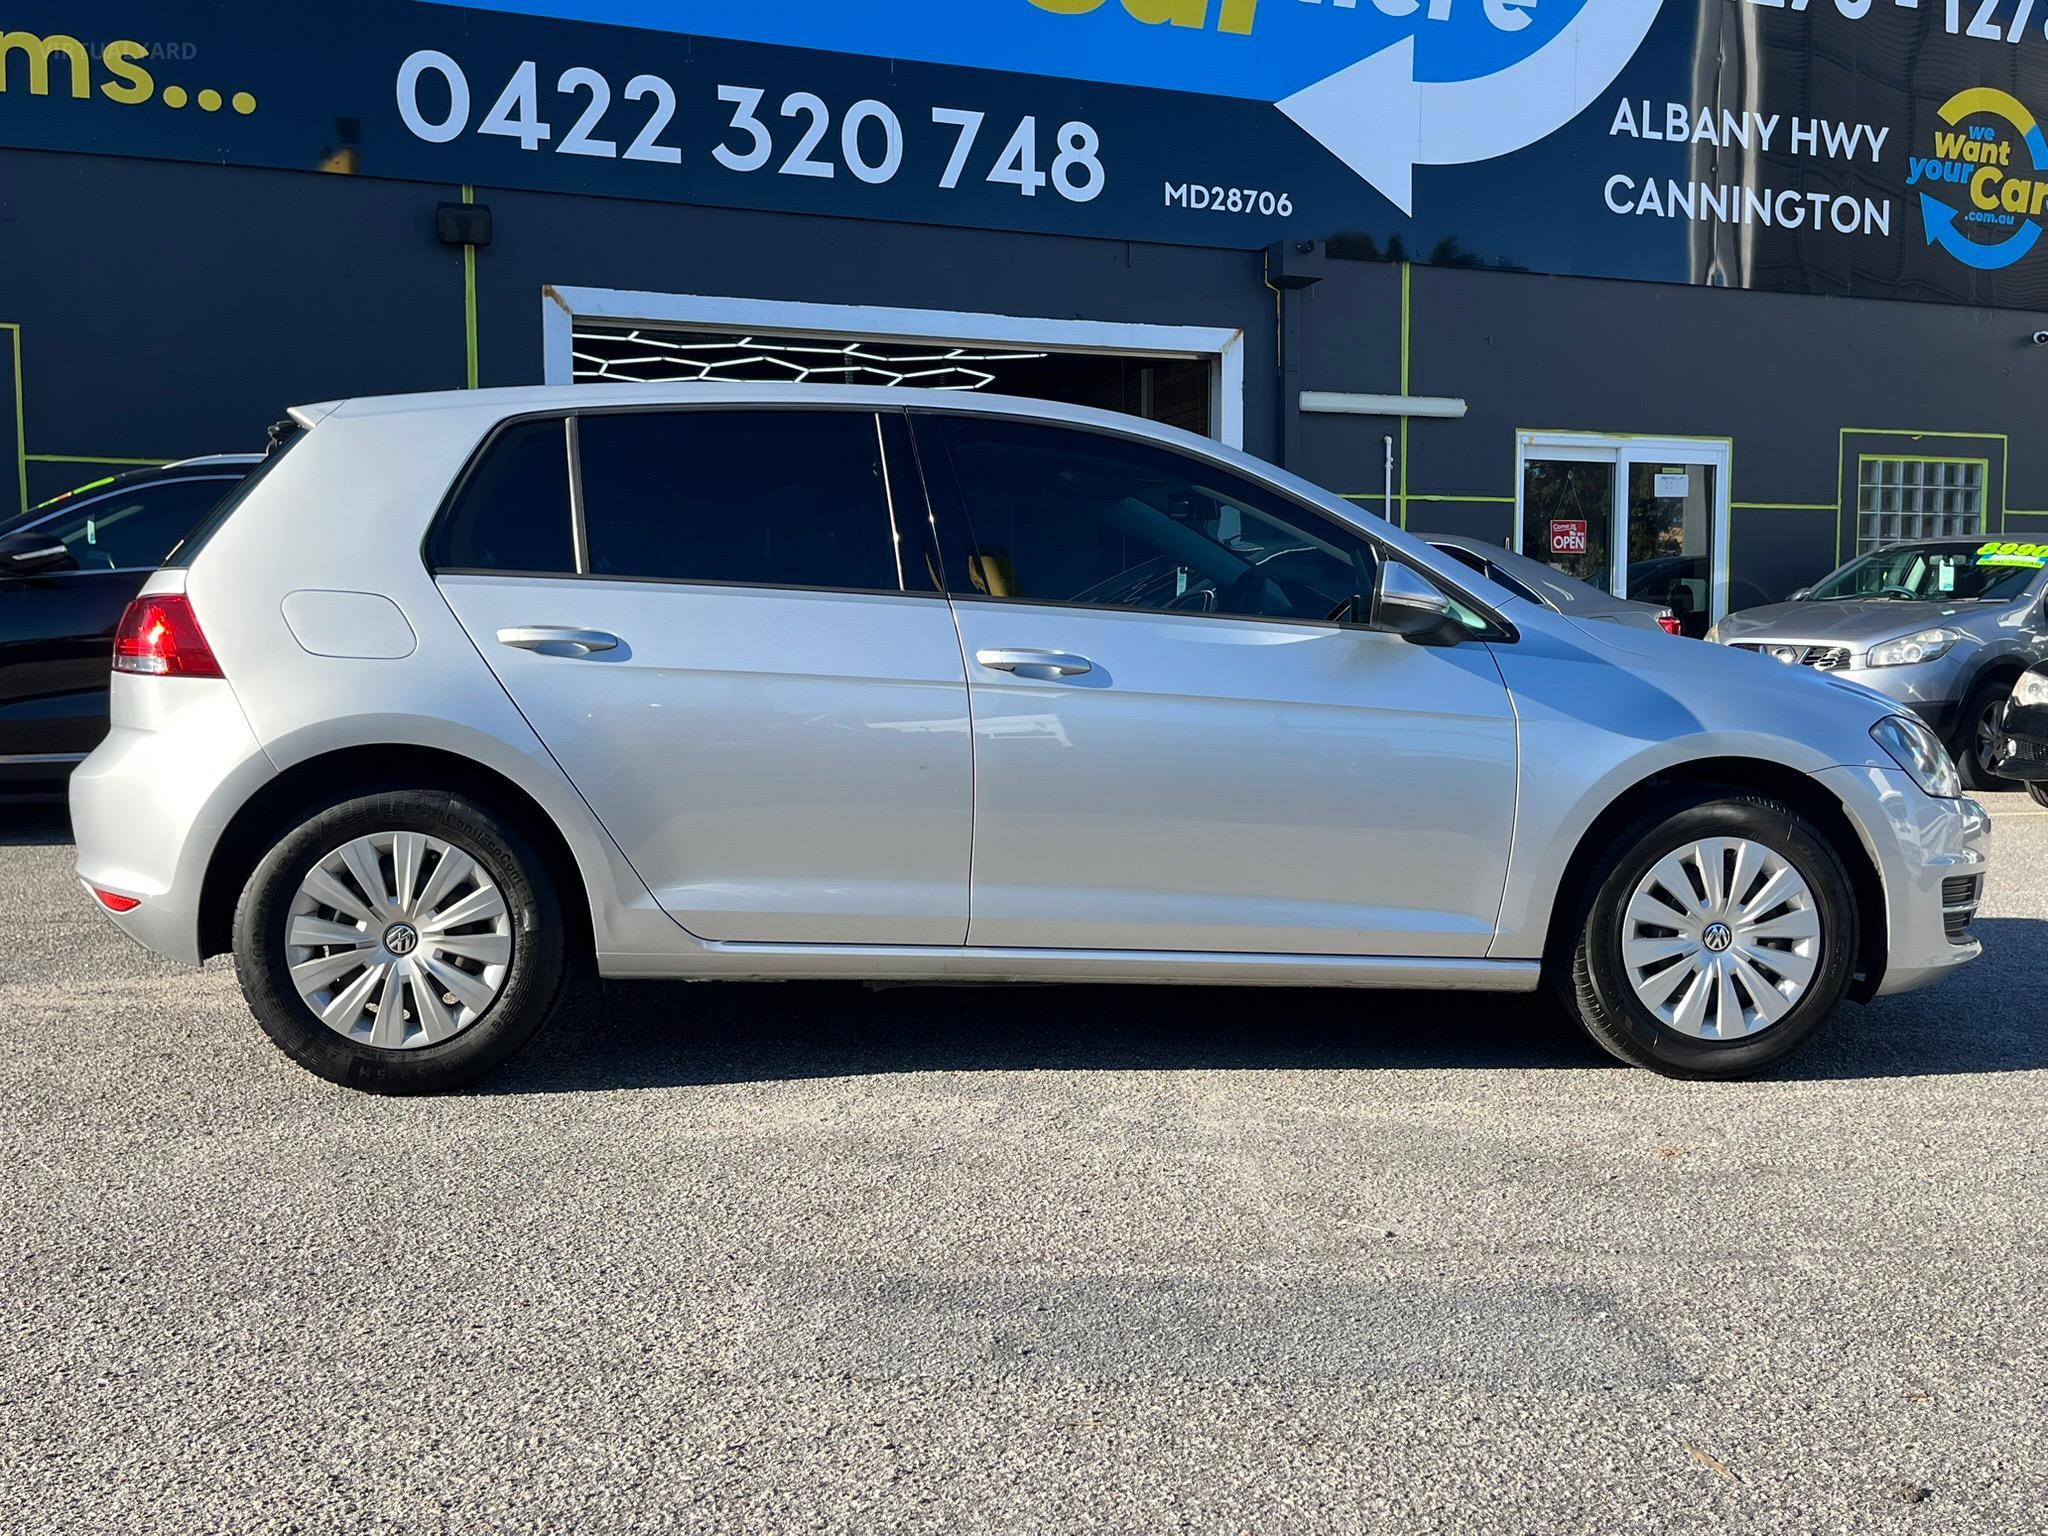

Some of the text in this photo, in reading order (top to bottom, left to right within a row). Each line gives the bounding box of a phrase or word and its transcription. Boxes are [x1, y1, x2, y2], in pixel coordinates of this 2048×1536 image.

[396, 50, 1105, 202] 0422 320 748
[1610, 97, 1889, 163] ALBANY HWY
[1968, 125, 1995, 141] we
[1934, 131, 2010, 165] Want
[1164, 181, 1293, 217] MD28706
[1905, 156, 2048, 215] your Car
[1604, 174, 1890, 237] CANNINGTON
[1964, 211, 2015, 225] .com.au
[1553, 536, 1585, 550] OPEN
